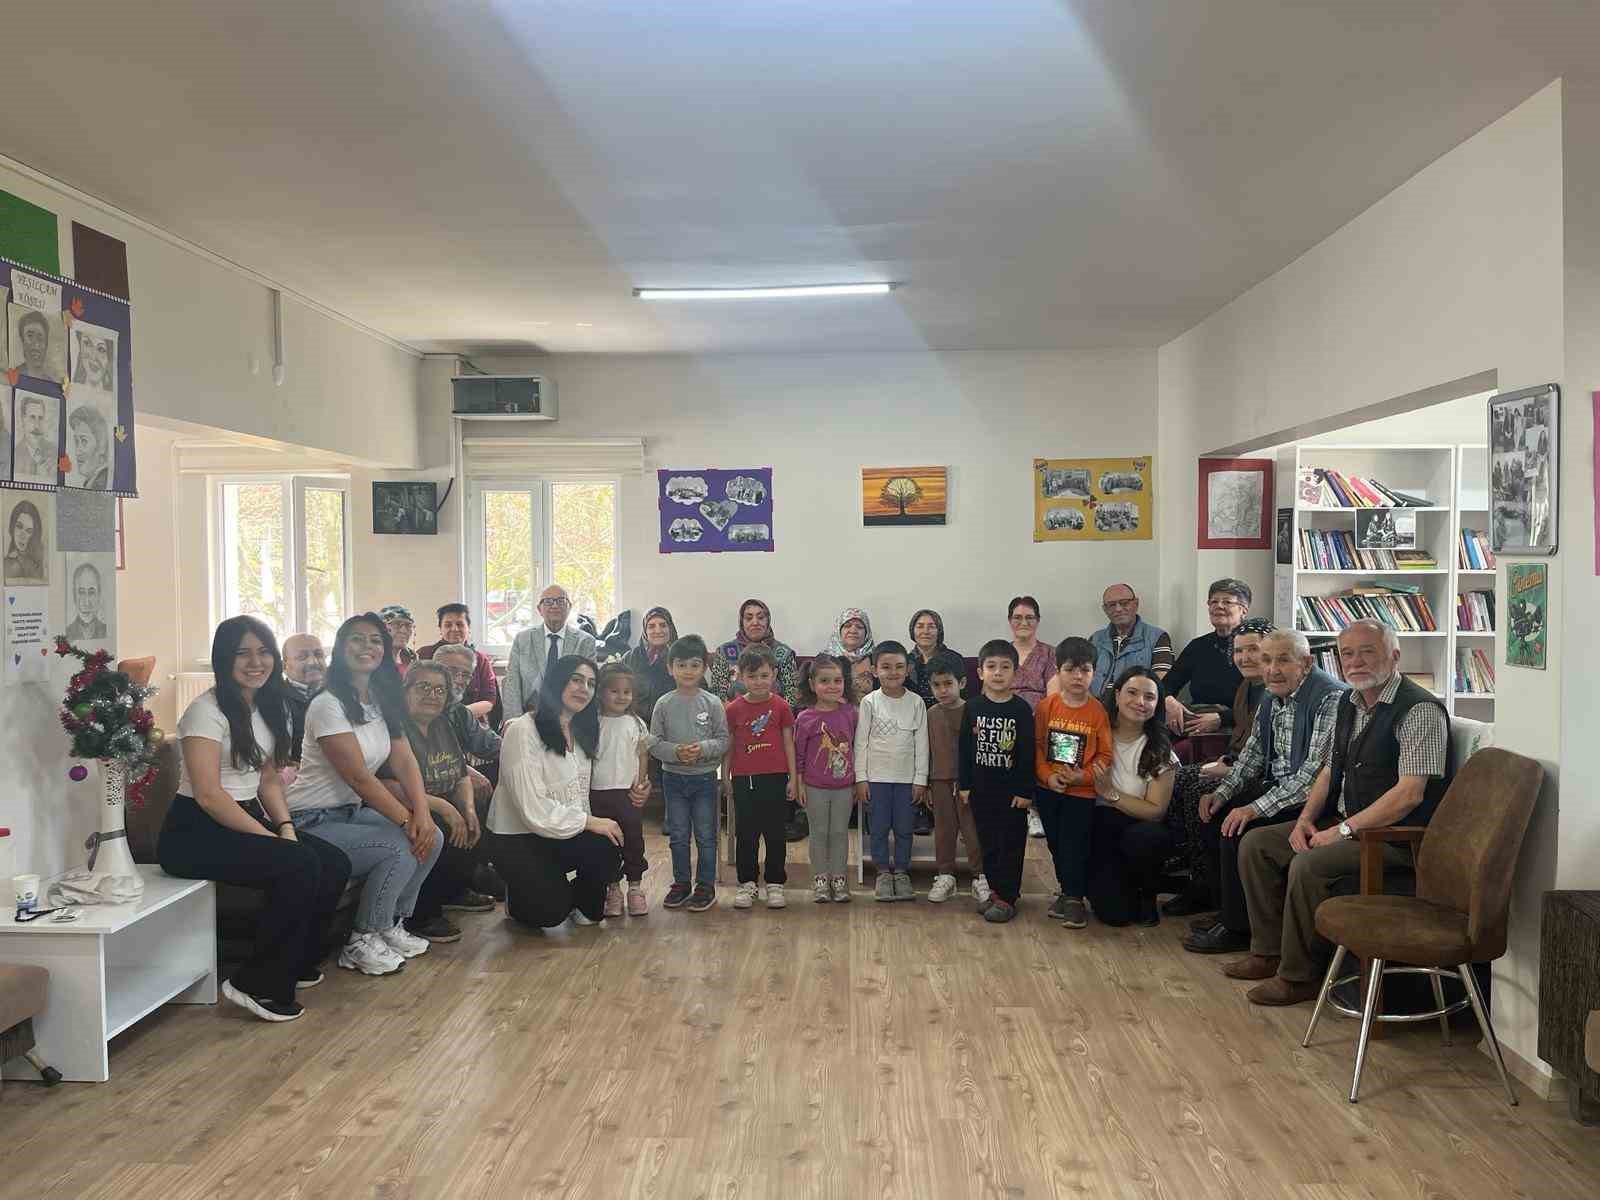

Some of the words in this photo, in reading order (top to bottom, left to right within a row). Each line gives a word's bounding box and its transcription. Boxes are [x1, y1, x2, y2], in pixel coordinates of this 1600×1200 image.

[976, 716, 1016, 730] MUSIC
[977, 729, 986, 741] IS
[976, 740, 998, 753] LET'S
[976, 752, 1011, 768] PARTY
